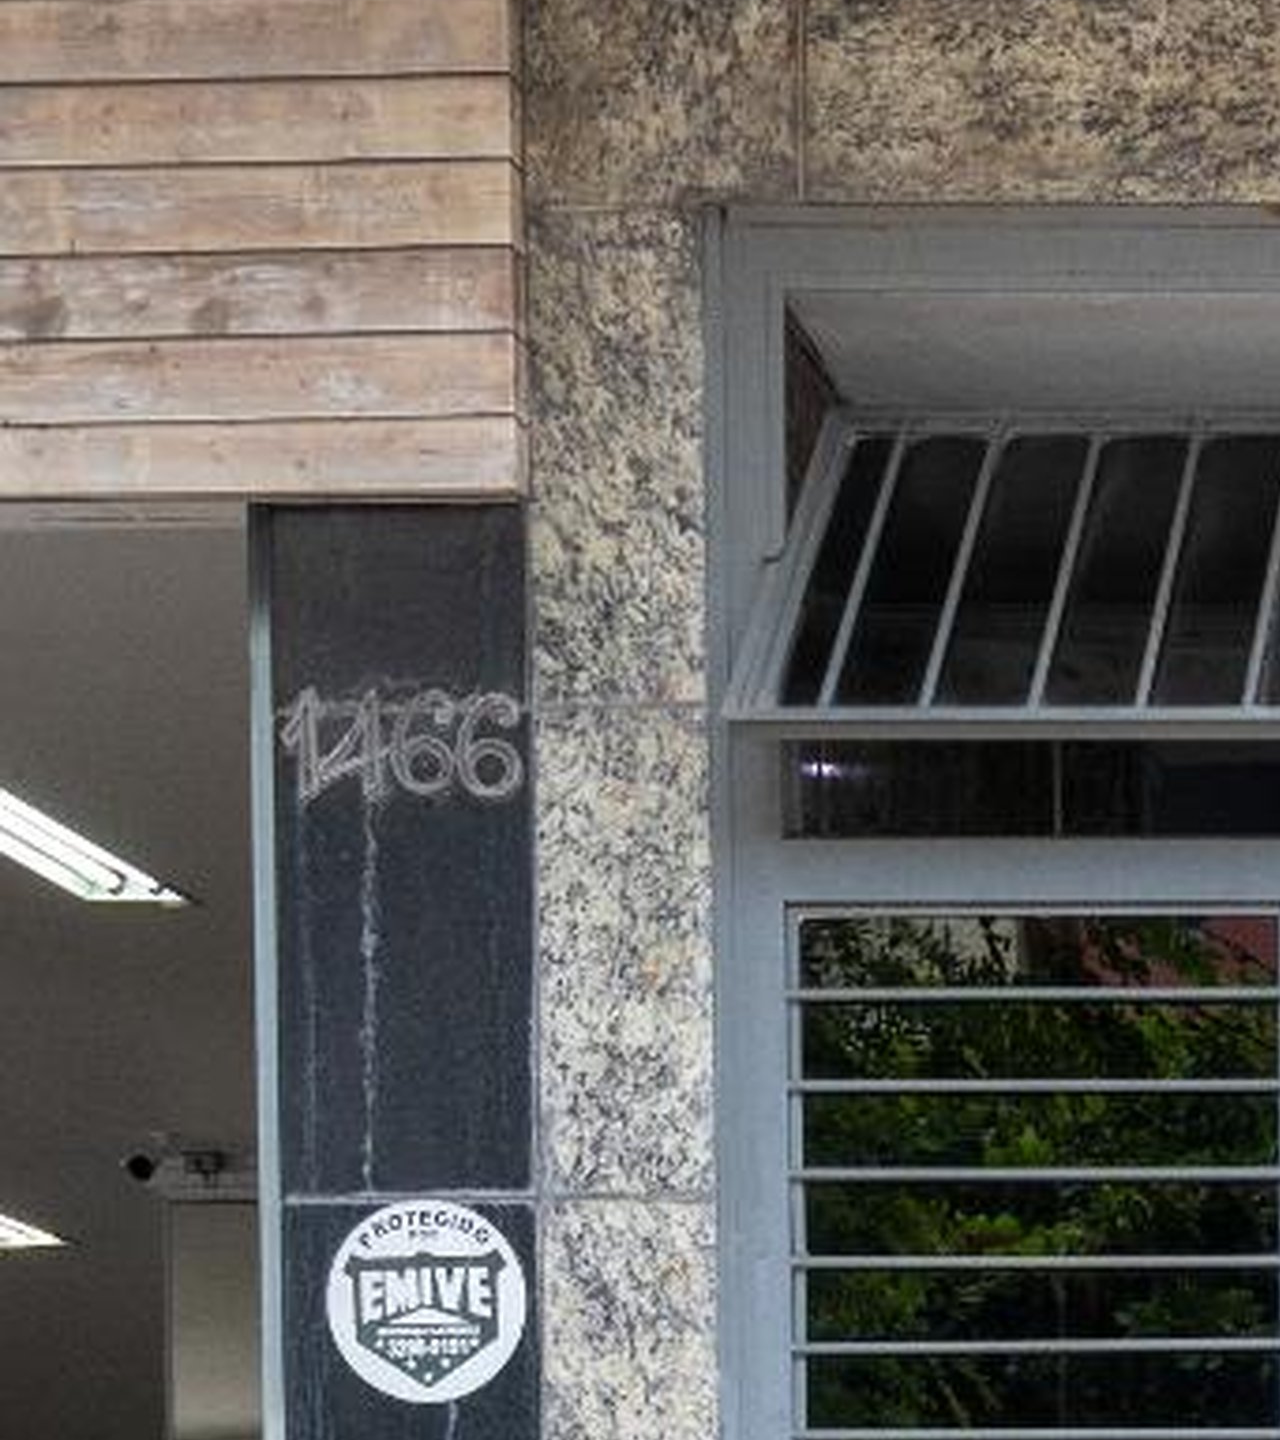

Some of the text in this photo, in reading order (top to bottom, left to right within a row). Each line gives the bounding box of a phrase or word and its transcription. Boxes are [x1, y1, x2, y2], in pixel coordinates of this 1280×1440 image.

[280, 685, 523, 798] 1466
[358, 1210, 489, 1250] PROTEGIDO
[359, 1265, 494, 1325] EMIVE
